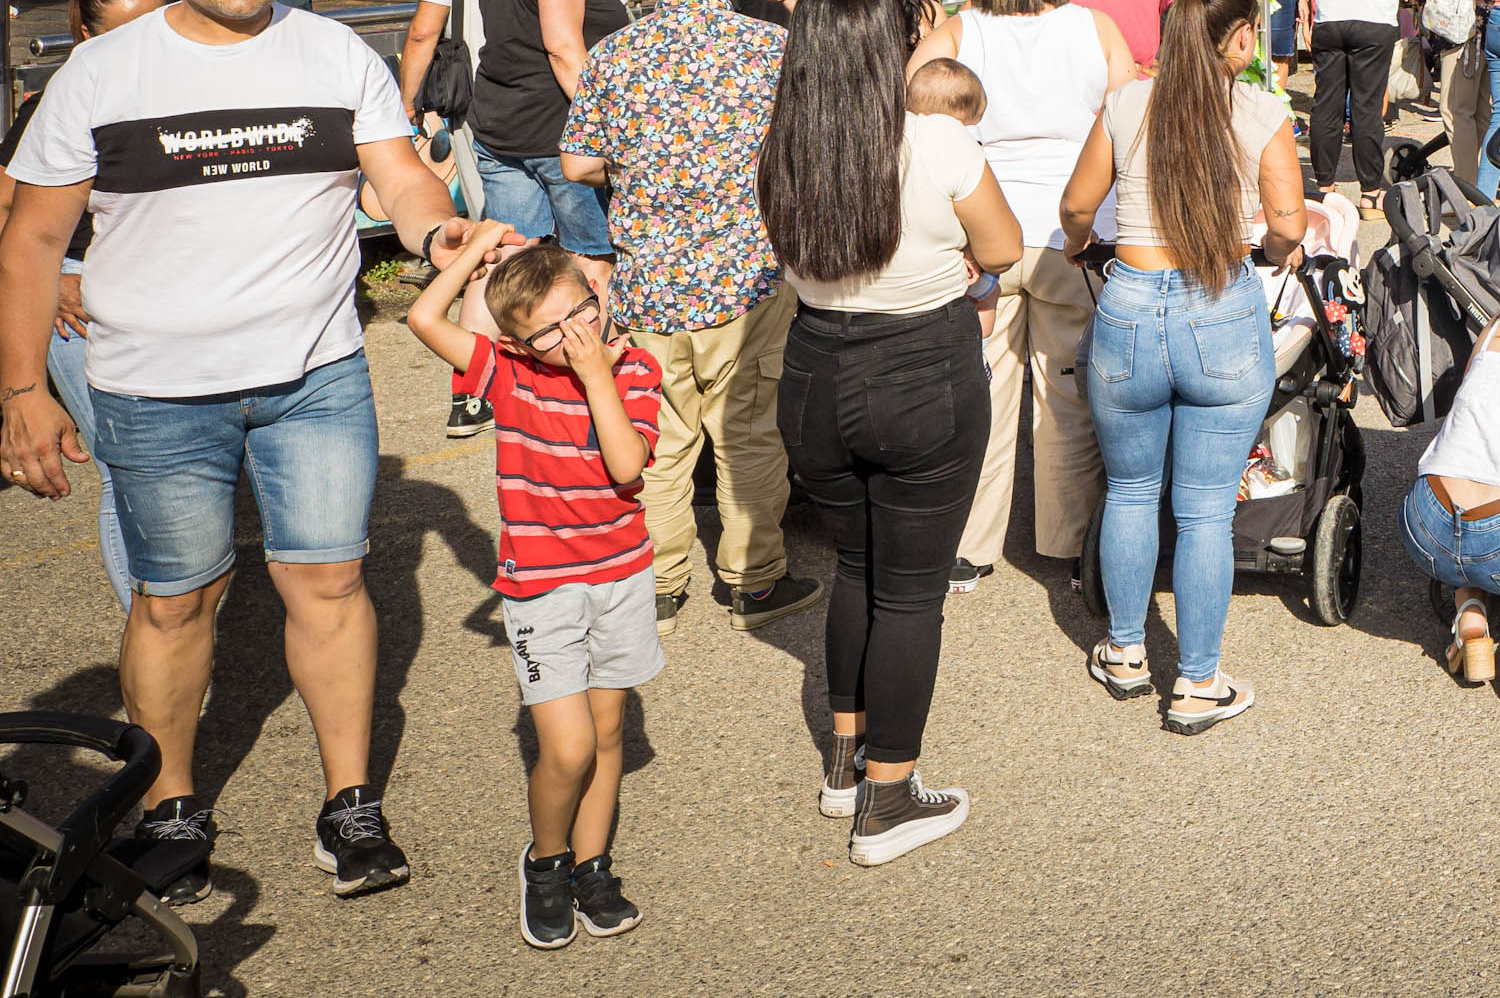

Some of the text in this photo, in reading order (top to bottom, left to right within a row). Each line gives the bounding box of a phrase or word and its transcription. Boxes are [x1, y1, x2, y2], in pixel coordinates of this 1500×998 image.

[159, 117, 307, 154] WORLDWIDE
[197, 151, 219, 159] YORK
[266, 144, 294, 153] TOKYO
[231, 160, 270, 174] WORLD
